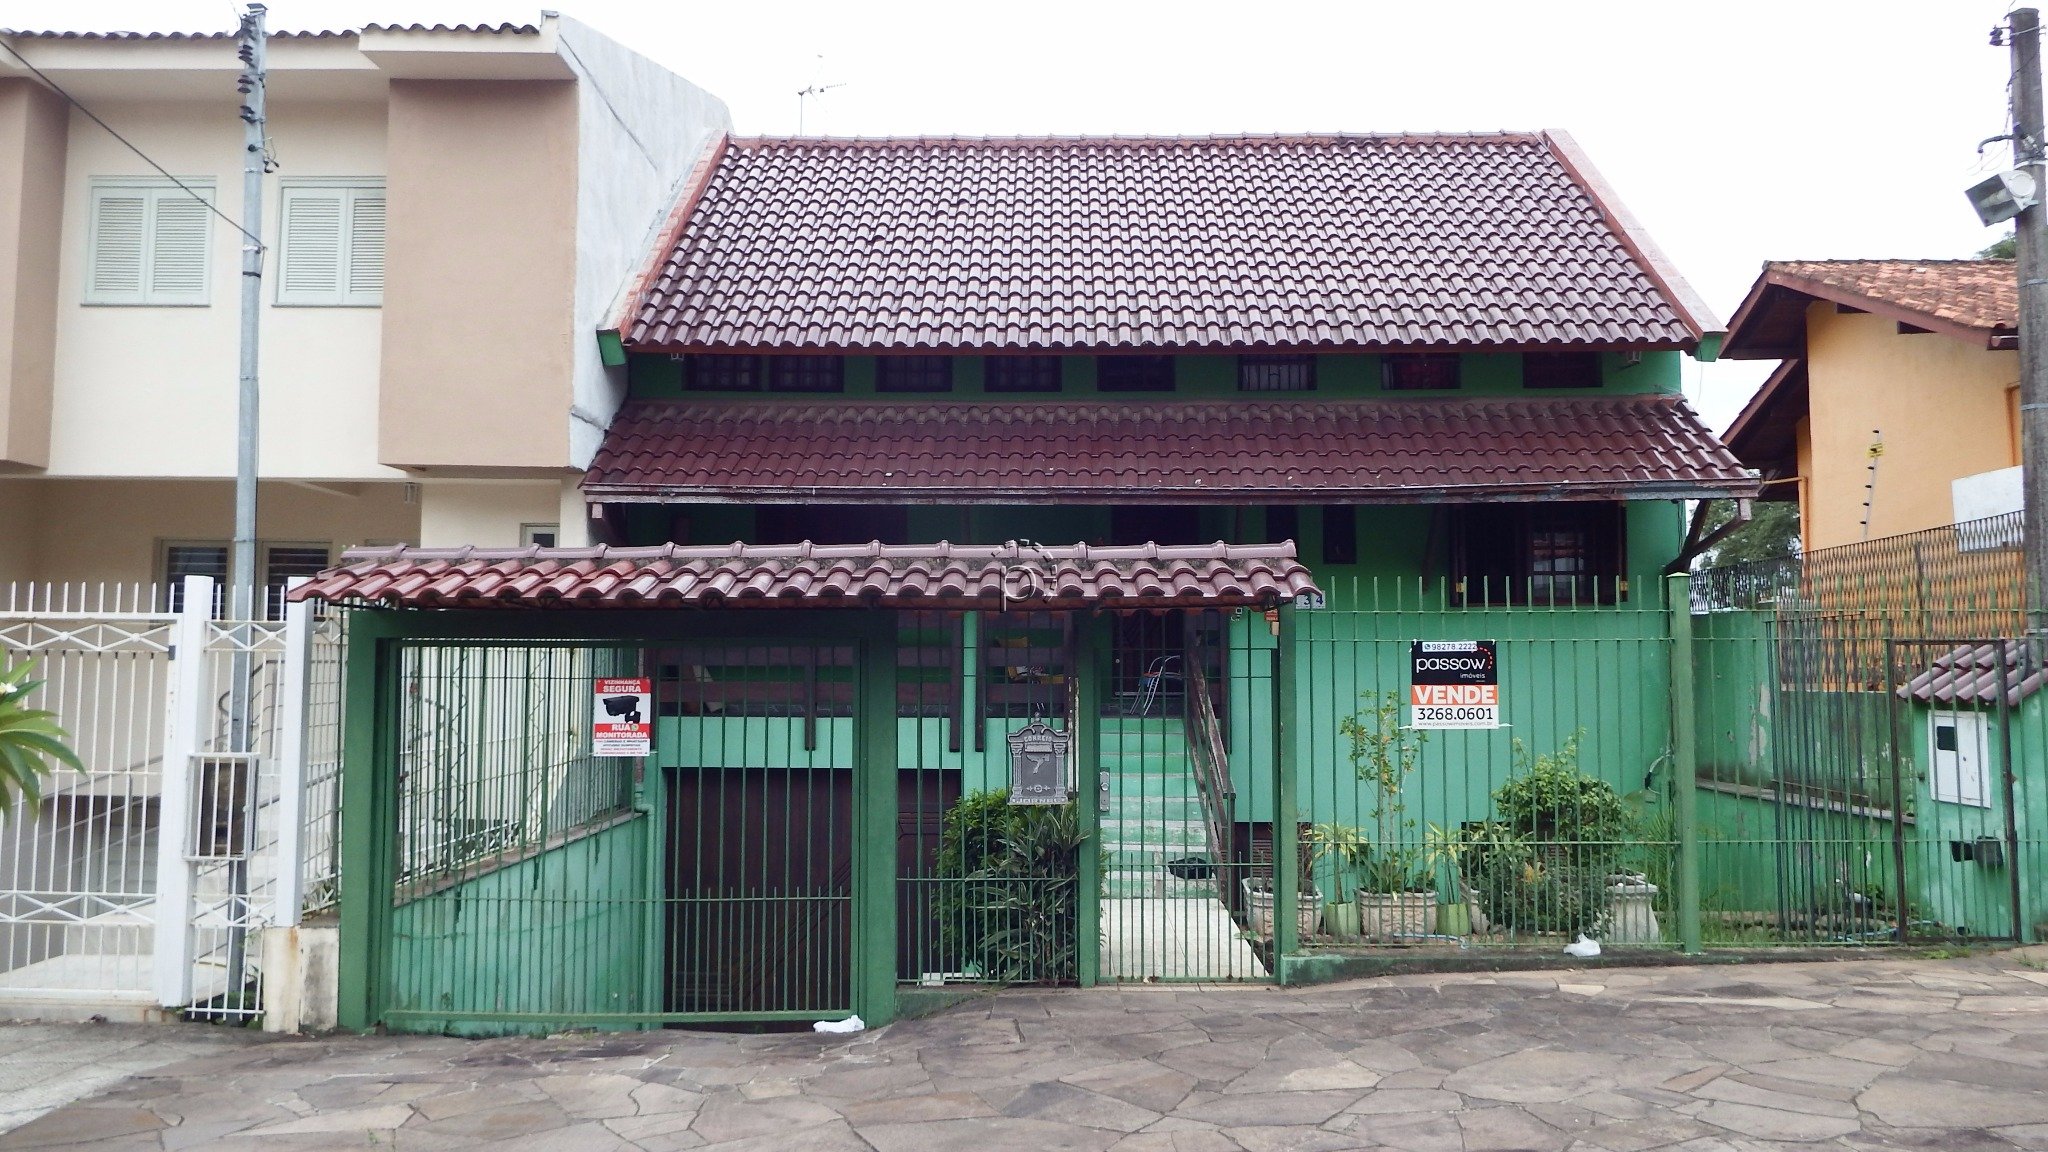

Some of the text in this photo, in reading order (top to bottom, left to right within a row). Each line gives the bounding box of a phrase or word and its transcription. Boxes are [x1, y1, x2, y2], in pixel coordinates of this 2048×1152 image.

[1431, 643, 1477, 651] 98278.2222
[1416, 658, 1486, 673] passow
[603, 685, 642, 693] SEGURA
[1414, 685, 1496, 705] VENDE
[1417, 707, 1493, 720] 3268.0601
[611, 723, 631, 732] RUA
[595, 731, 648, 739] MONITORADA
